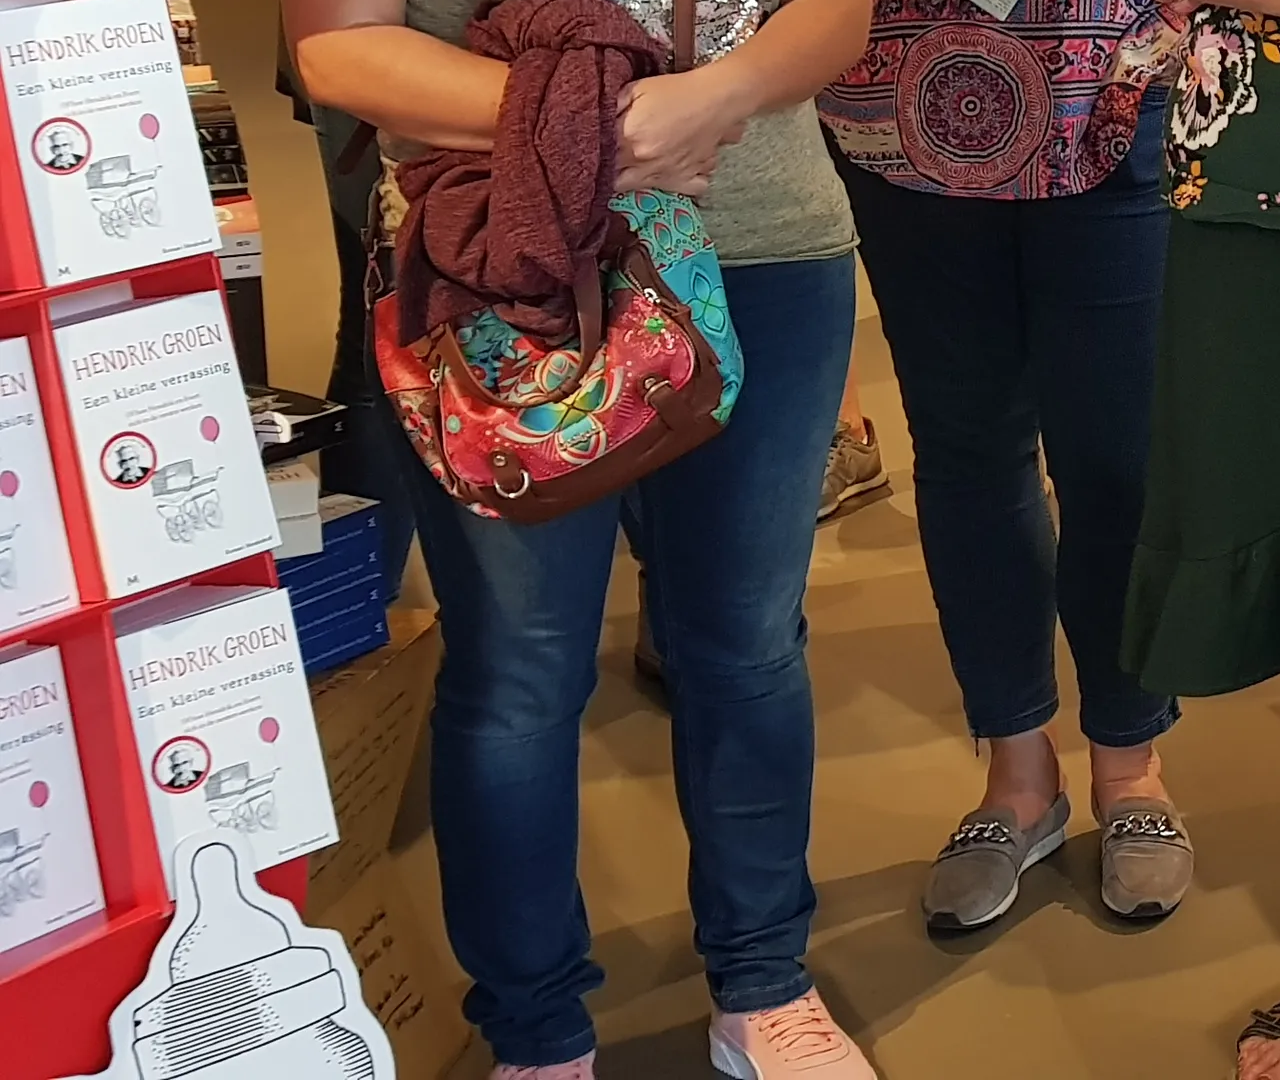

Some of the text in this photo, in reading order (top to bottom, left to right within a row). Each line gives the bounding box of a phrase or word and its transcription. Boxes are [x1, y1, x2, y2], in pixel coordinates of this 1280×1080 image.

[5, 22, 166, 67] HENDRIK GROEN
[16, 60, 174, 97] Een kleine verrassing
[71, 323, 223, 381] HENDRIK GROEN
[82, 395, 110, 410] Een
[113, 382, 157, 401] kleine
[160, 361, 231, 388] verrassing
[128, 623, 288, 691] HENDRIK GROEN
[137, 704, 165, 719] Een
[170, 687, 215, 708] kleine
[220, 661, 295, 693] verrassing
[0, 721, 64, 752] errassing
